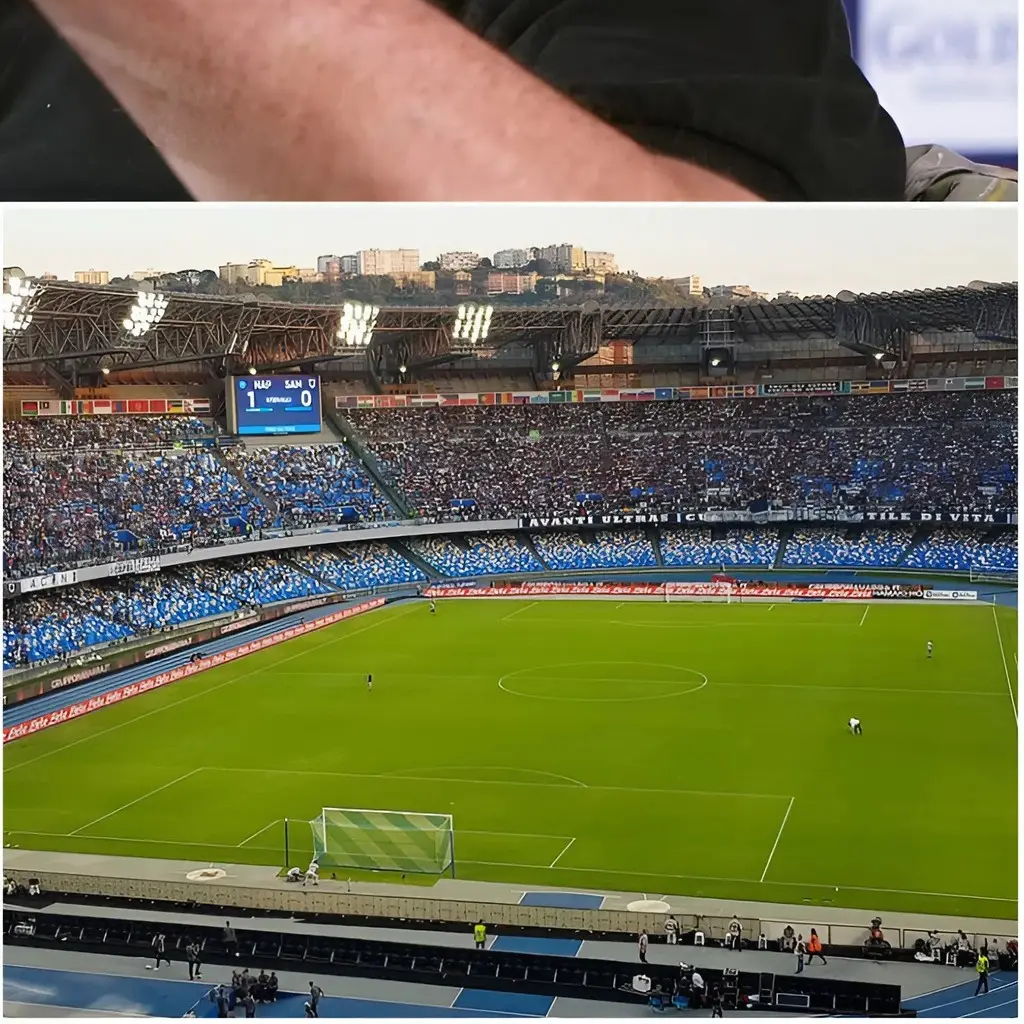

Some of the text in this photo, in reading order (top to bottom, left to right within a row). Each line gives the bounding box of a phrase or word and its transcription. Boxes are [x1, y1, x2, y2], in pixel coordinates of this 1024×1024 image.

[247, 391, 255, 408] 1
[301, 390, 312, 406] 0
[529, 516, 593, 527] AVANTI
[601, 513, 669, 524] ULTRAS
[921, 513, 942, 521] DI
[949, 513, 995, 523] VITA
